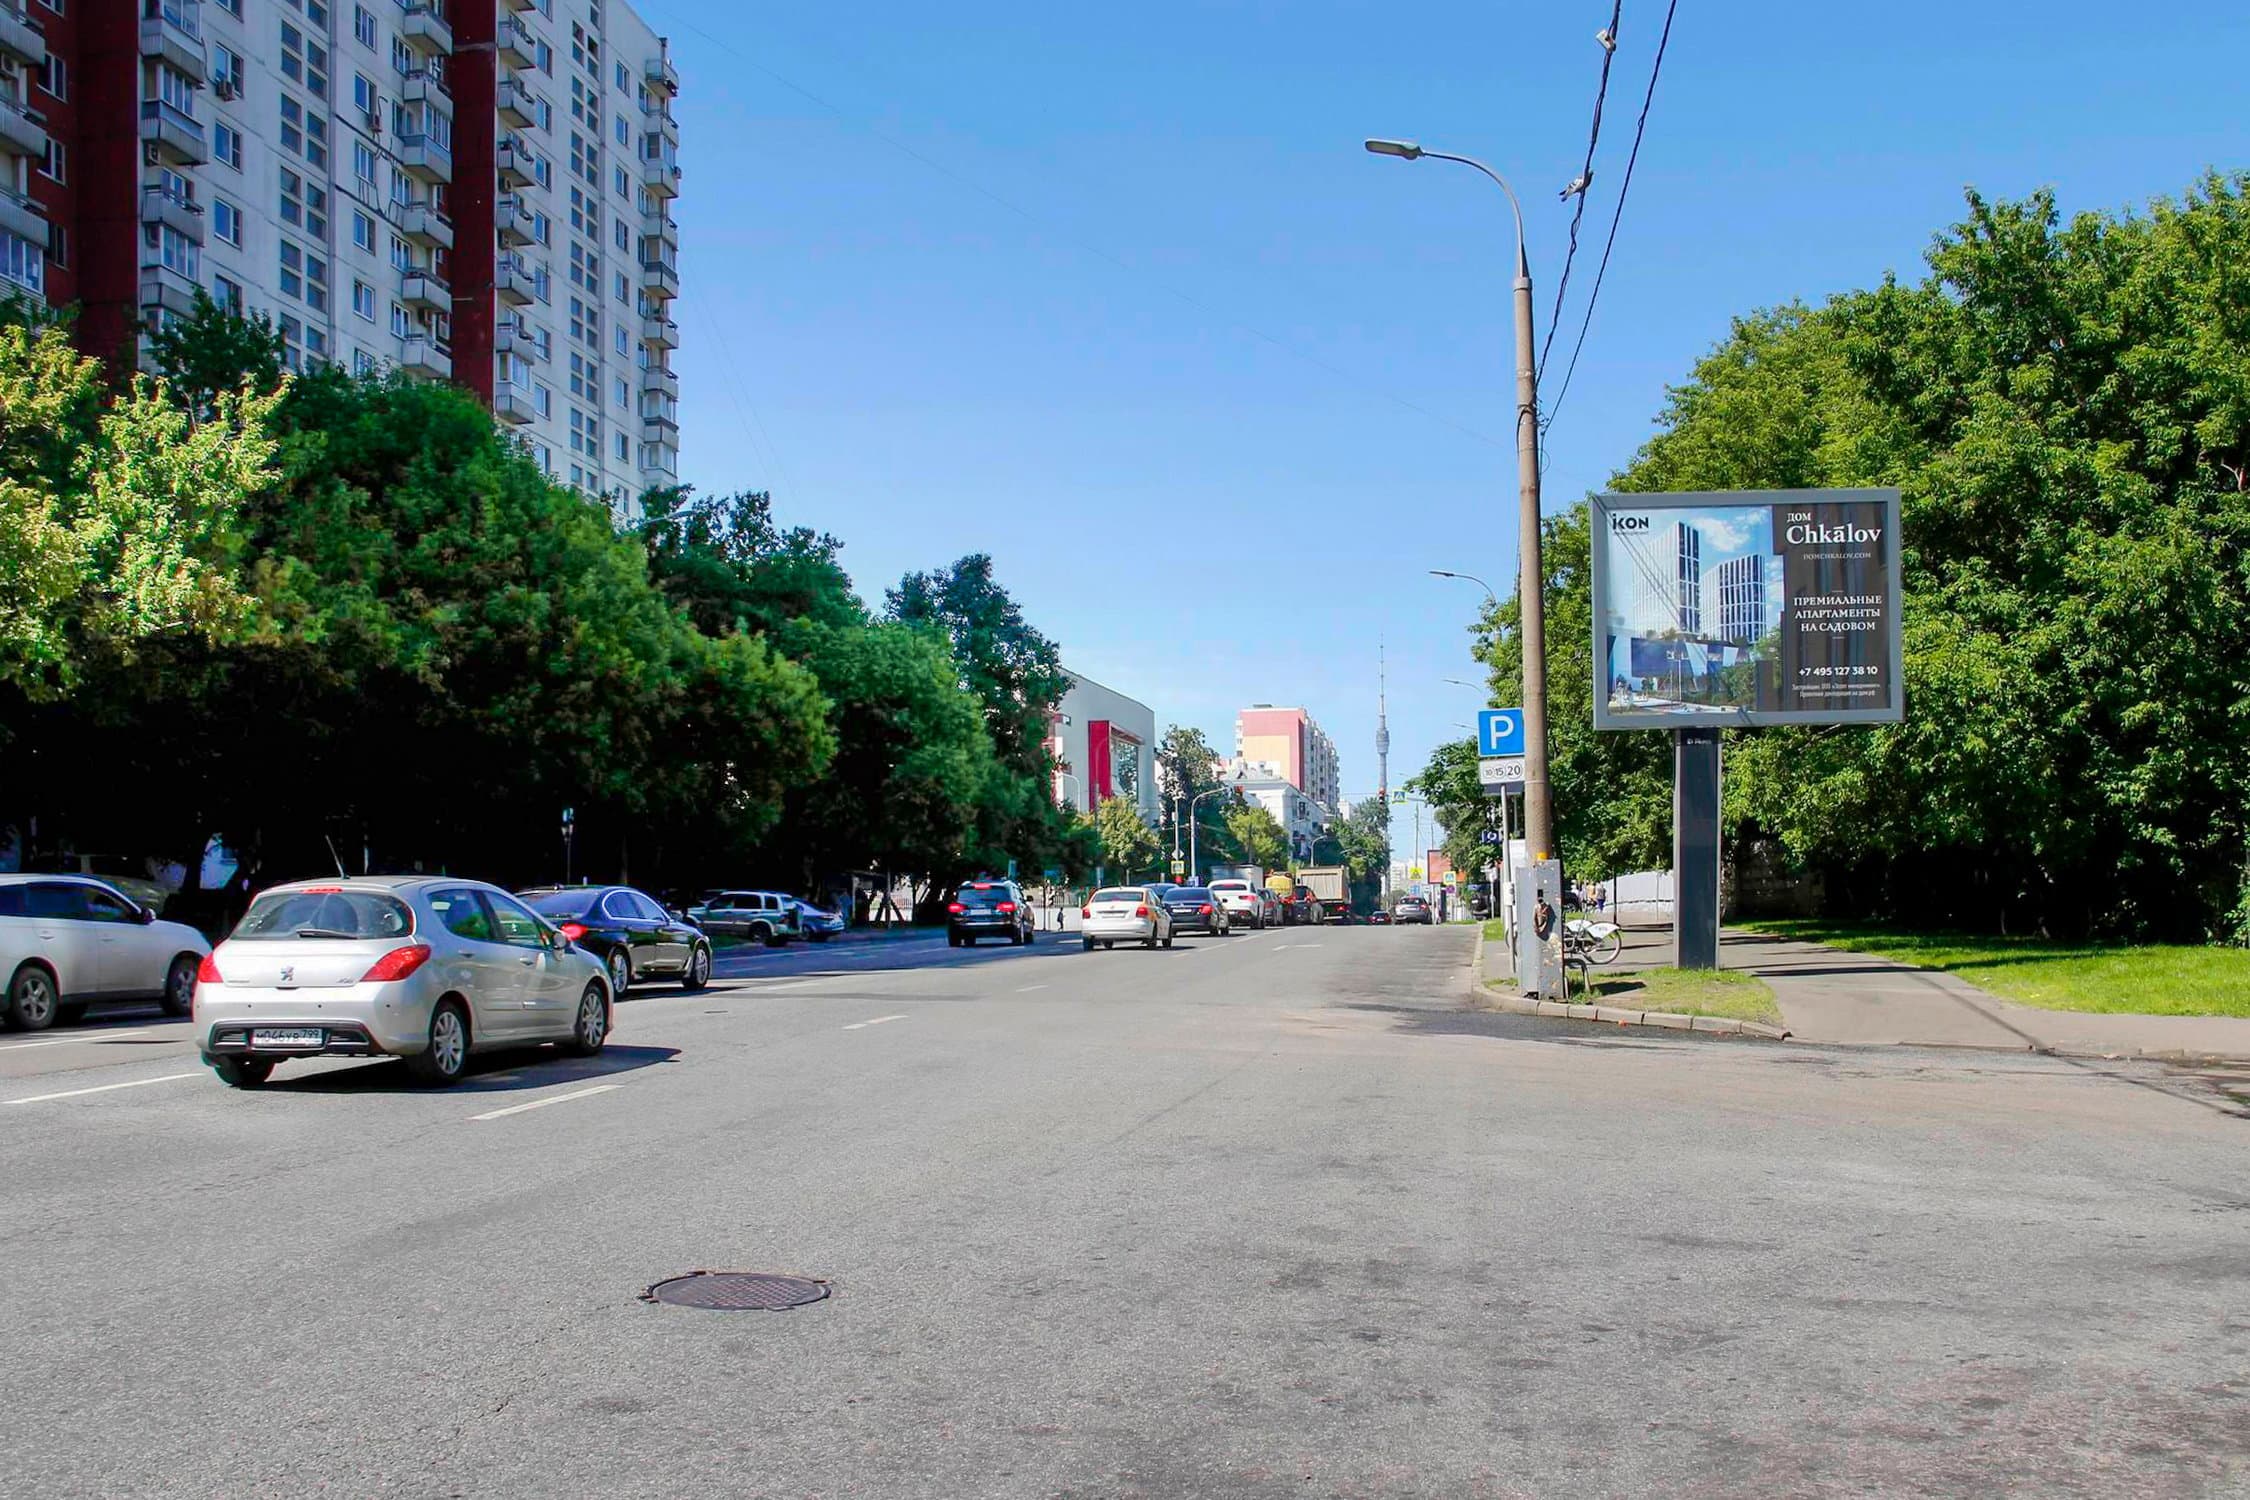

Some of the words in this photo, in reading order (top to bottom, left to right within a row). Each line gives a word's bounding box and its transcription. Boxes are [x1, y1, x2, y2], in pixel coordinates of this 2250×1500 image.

[1786, 512, 1811, 522] ДОМ
[1793, 595, 1882, 606] ПРЕМИАЛЬНЫЕ
[1794, 608, 1881, 619] АПАРТАМЕНТЫ
[1801, 622, 1817, 632] НА
[1819, 622, 1876, 633] САДОВОМ
[1799, 667, 1811, 676] +7
[1813, 667, 1833, 676] 495
[1834, 666, 1850, 675] 127
[1852, 666, 1865, 675] 38
[1866, 666, 1878, 675] 10
[1495, 767, 1504, 776] 15
[1507, 765, 1521, 776] 20
